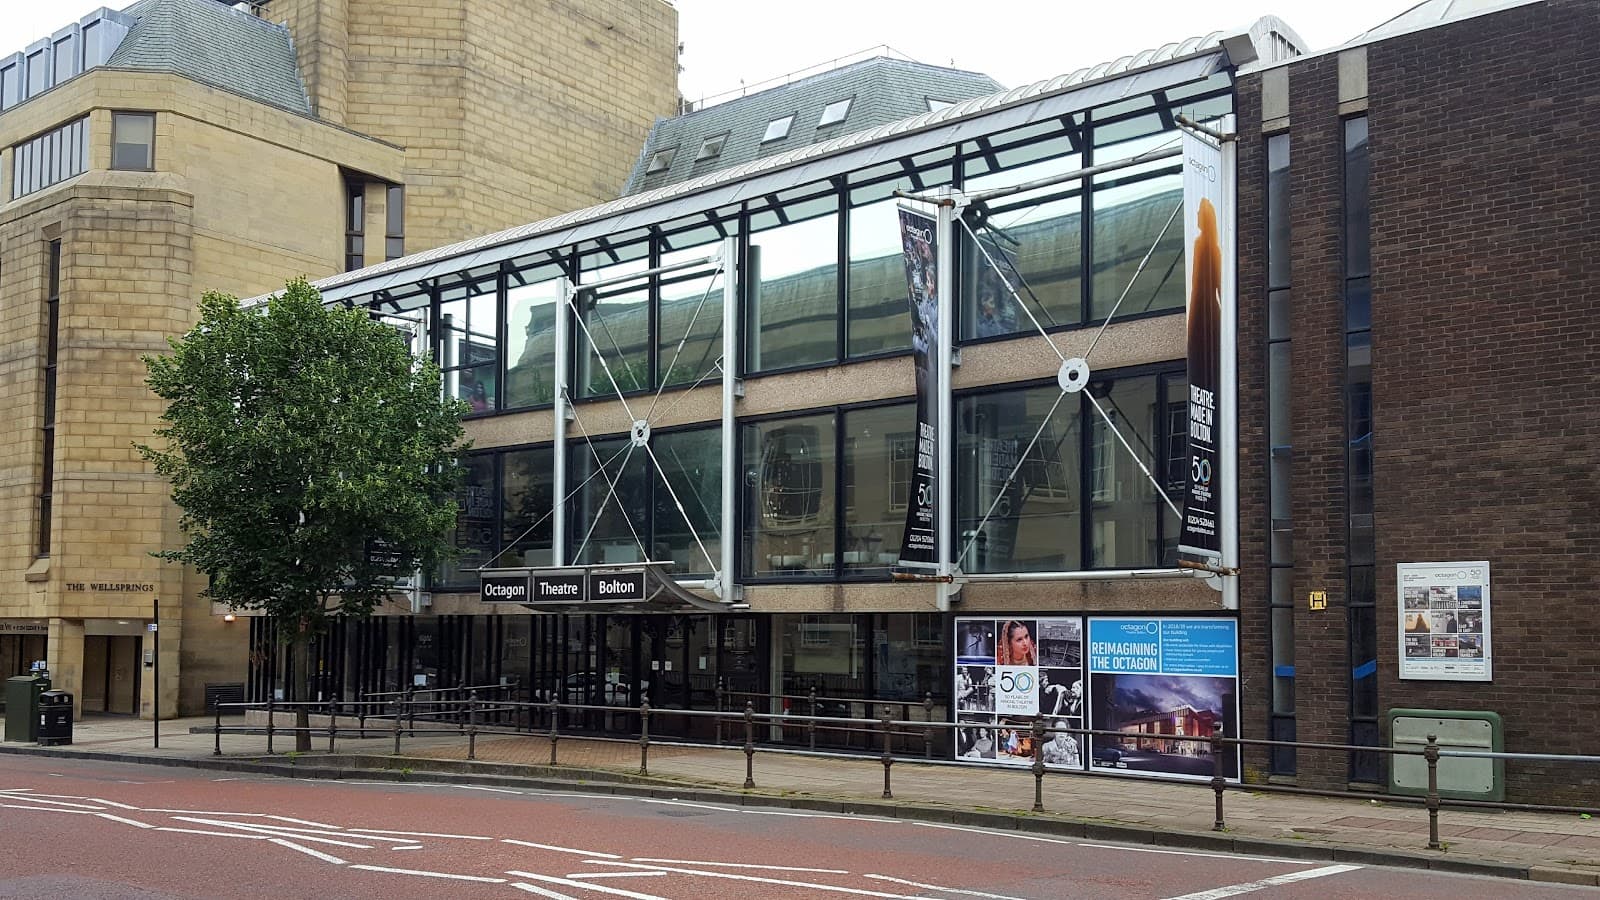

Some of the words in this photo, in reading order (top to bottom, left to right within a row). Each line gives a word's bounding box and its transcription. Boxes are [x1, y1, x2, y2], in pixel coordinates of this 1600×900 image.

[1190, 402, 1206, 424] MADE
[1205, 408, 1213, 426] IN
[1191, 455, 1212, 485] 50
[917, 483, 933, 506] 50
[66, 583, 85, 592] THE
[90, 583, 154, 592] WELLSPRINGS
[484, 583, 525, 598] Octagon
[539, 582, 578, 595] Theatre
[599, 580, 635, 594] Bolton
[1312, 593, 1324, 608] H
[1092, 641, 1158, 656] REIMAGINING
[1092, 656, 1110, 670] THE
[1112, 656, 1158, 671] OCTAGON
[1000, 671, 1034, 694] 50
